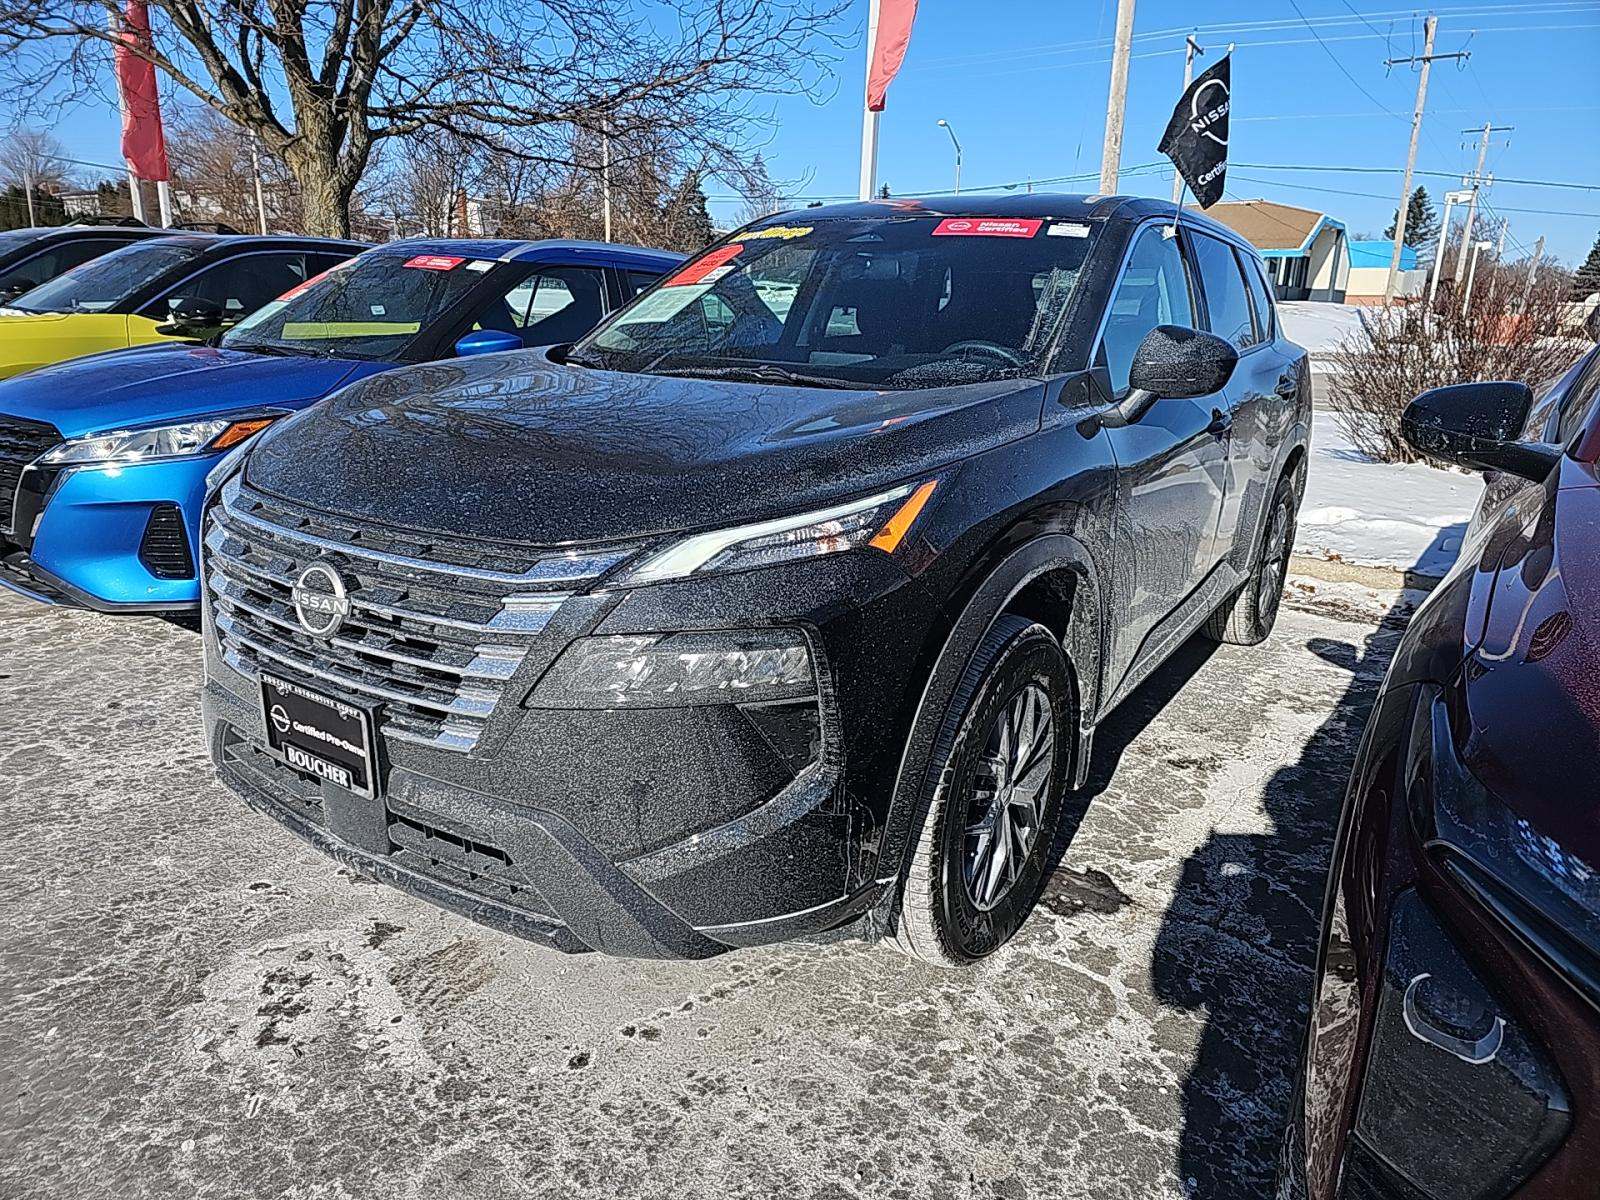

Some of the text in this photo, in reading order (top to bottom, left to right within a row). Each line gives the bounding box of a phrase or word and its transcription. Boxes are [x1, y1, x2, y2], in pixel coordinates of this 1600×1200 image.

[1191, 101, 1229, 133] NISSA
[1197, 160, 1227, 185] Certifi
[291, 587, 349, 615] NISSAN
[292, 721, 366, 757] Certified Pre-Owne
[287, 747, 349, 787] BOUCHER
